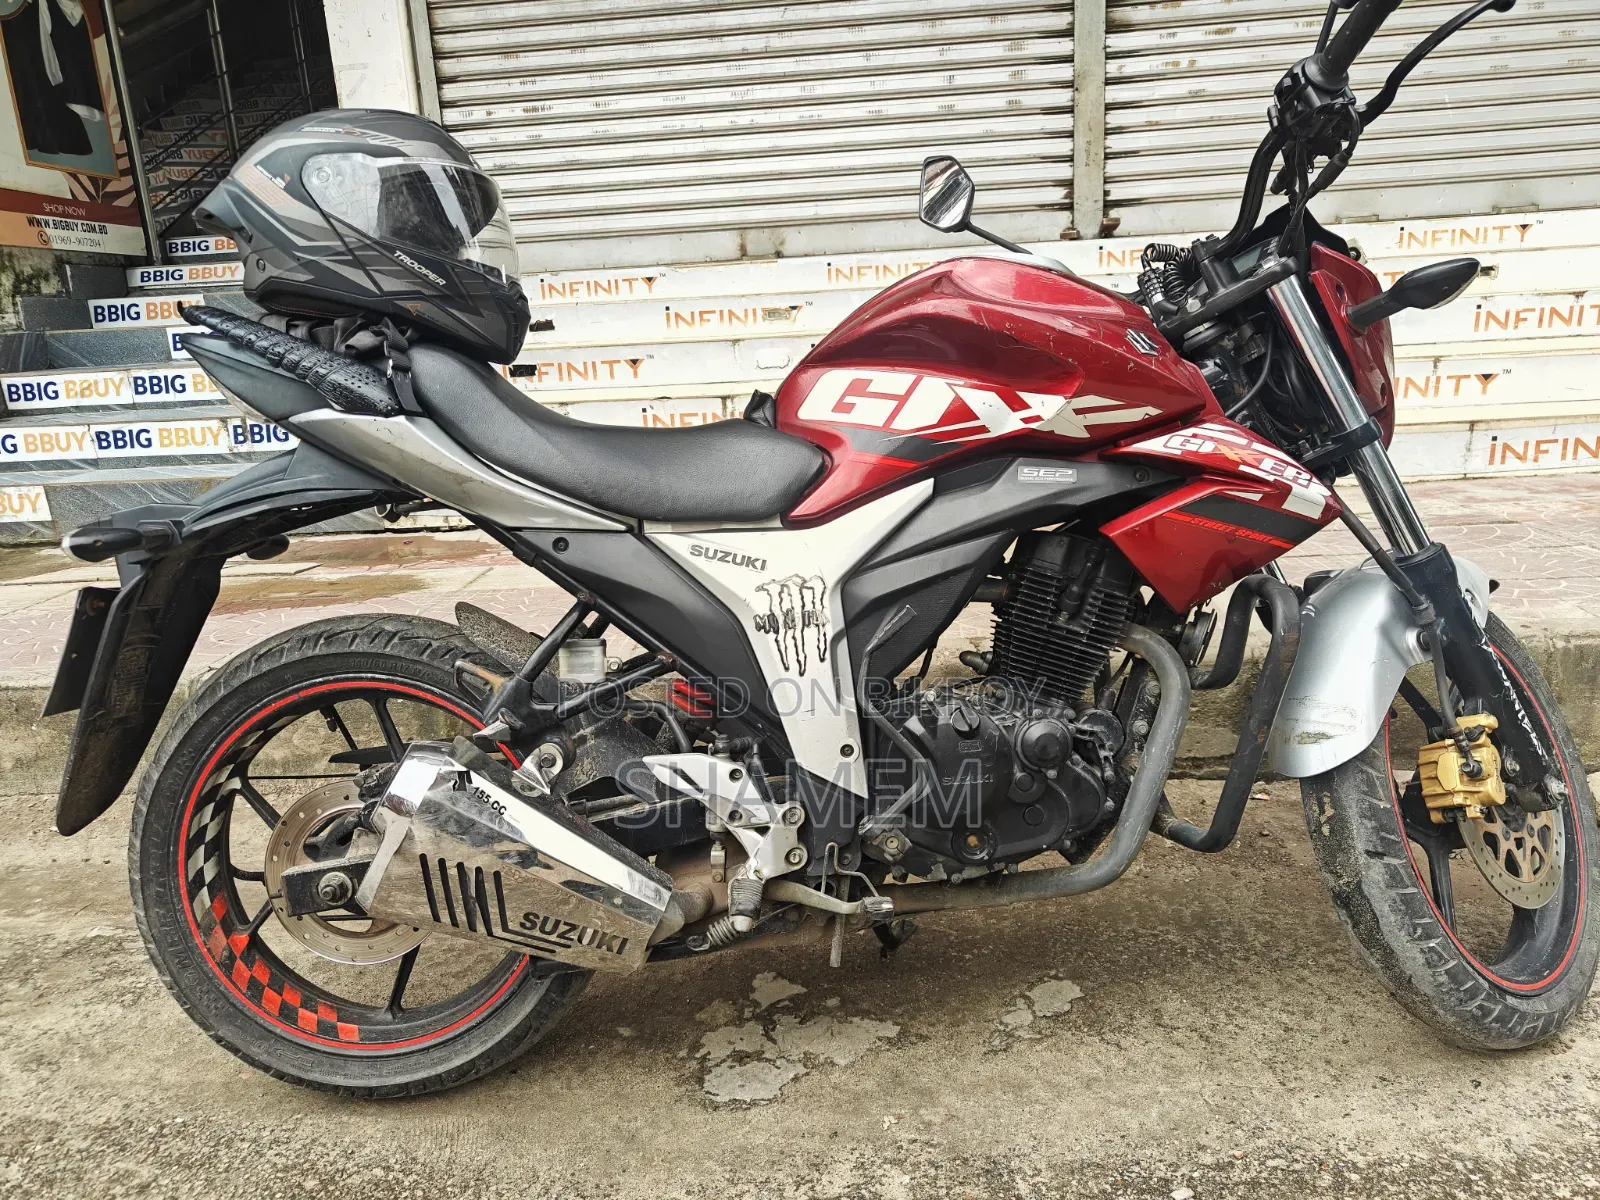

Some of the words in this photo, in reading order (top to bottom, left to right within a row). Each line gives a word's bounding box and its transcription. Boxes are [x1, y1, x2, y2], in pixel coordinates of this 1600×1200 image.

[43, 202, 64, 214] SHOP
[65, 204, 86, 216] NOW
[26, 216, 108, 235] WWW.BIGBUY.COM.BD
[48, 234, 101, 248] 01969-907204
[168, 240, 210, 253] BBIG
[214, 238, 238, 251] BB
[140, 268, 184, 283] BBIG
[188, 265, 240, 280] BBUY
[393, 250, 447, 286] TROOPER
[93, 303, 141, 323] BBIG
[7, 381, 59, 403] BBIG
[64, 376, 125, 399] BBUY
[133, 374, 187, 396] BBIG
[192, 372, 219, 393] BB
[24, 431, 88, 454] BBUY
[95, 428, 152, 450] BBIG
[158, 425, 223, 449] BBUY
[232, 423, 290, 446] BBIG
[1021, 468, 1073, 477] SEP
[1163, 434, 1314, 489] GIXXER
[1191, 517, 1235, 533] STREET
[1235, 529, 1273, 542] SPORT
[689, 543, 768, 572] SUZUKI
[473, 787, 491, 804] 155
[491, 800, 507, 816] CC
[519, 911, 629, 955] SUZUKI
